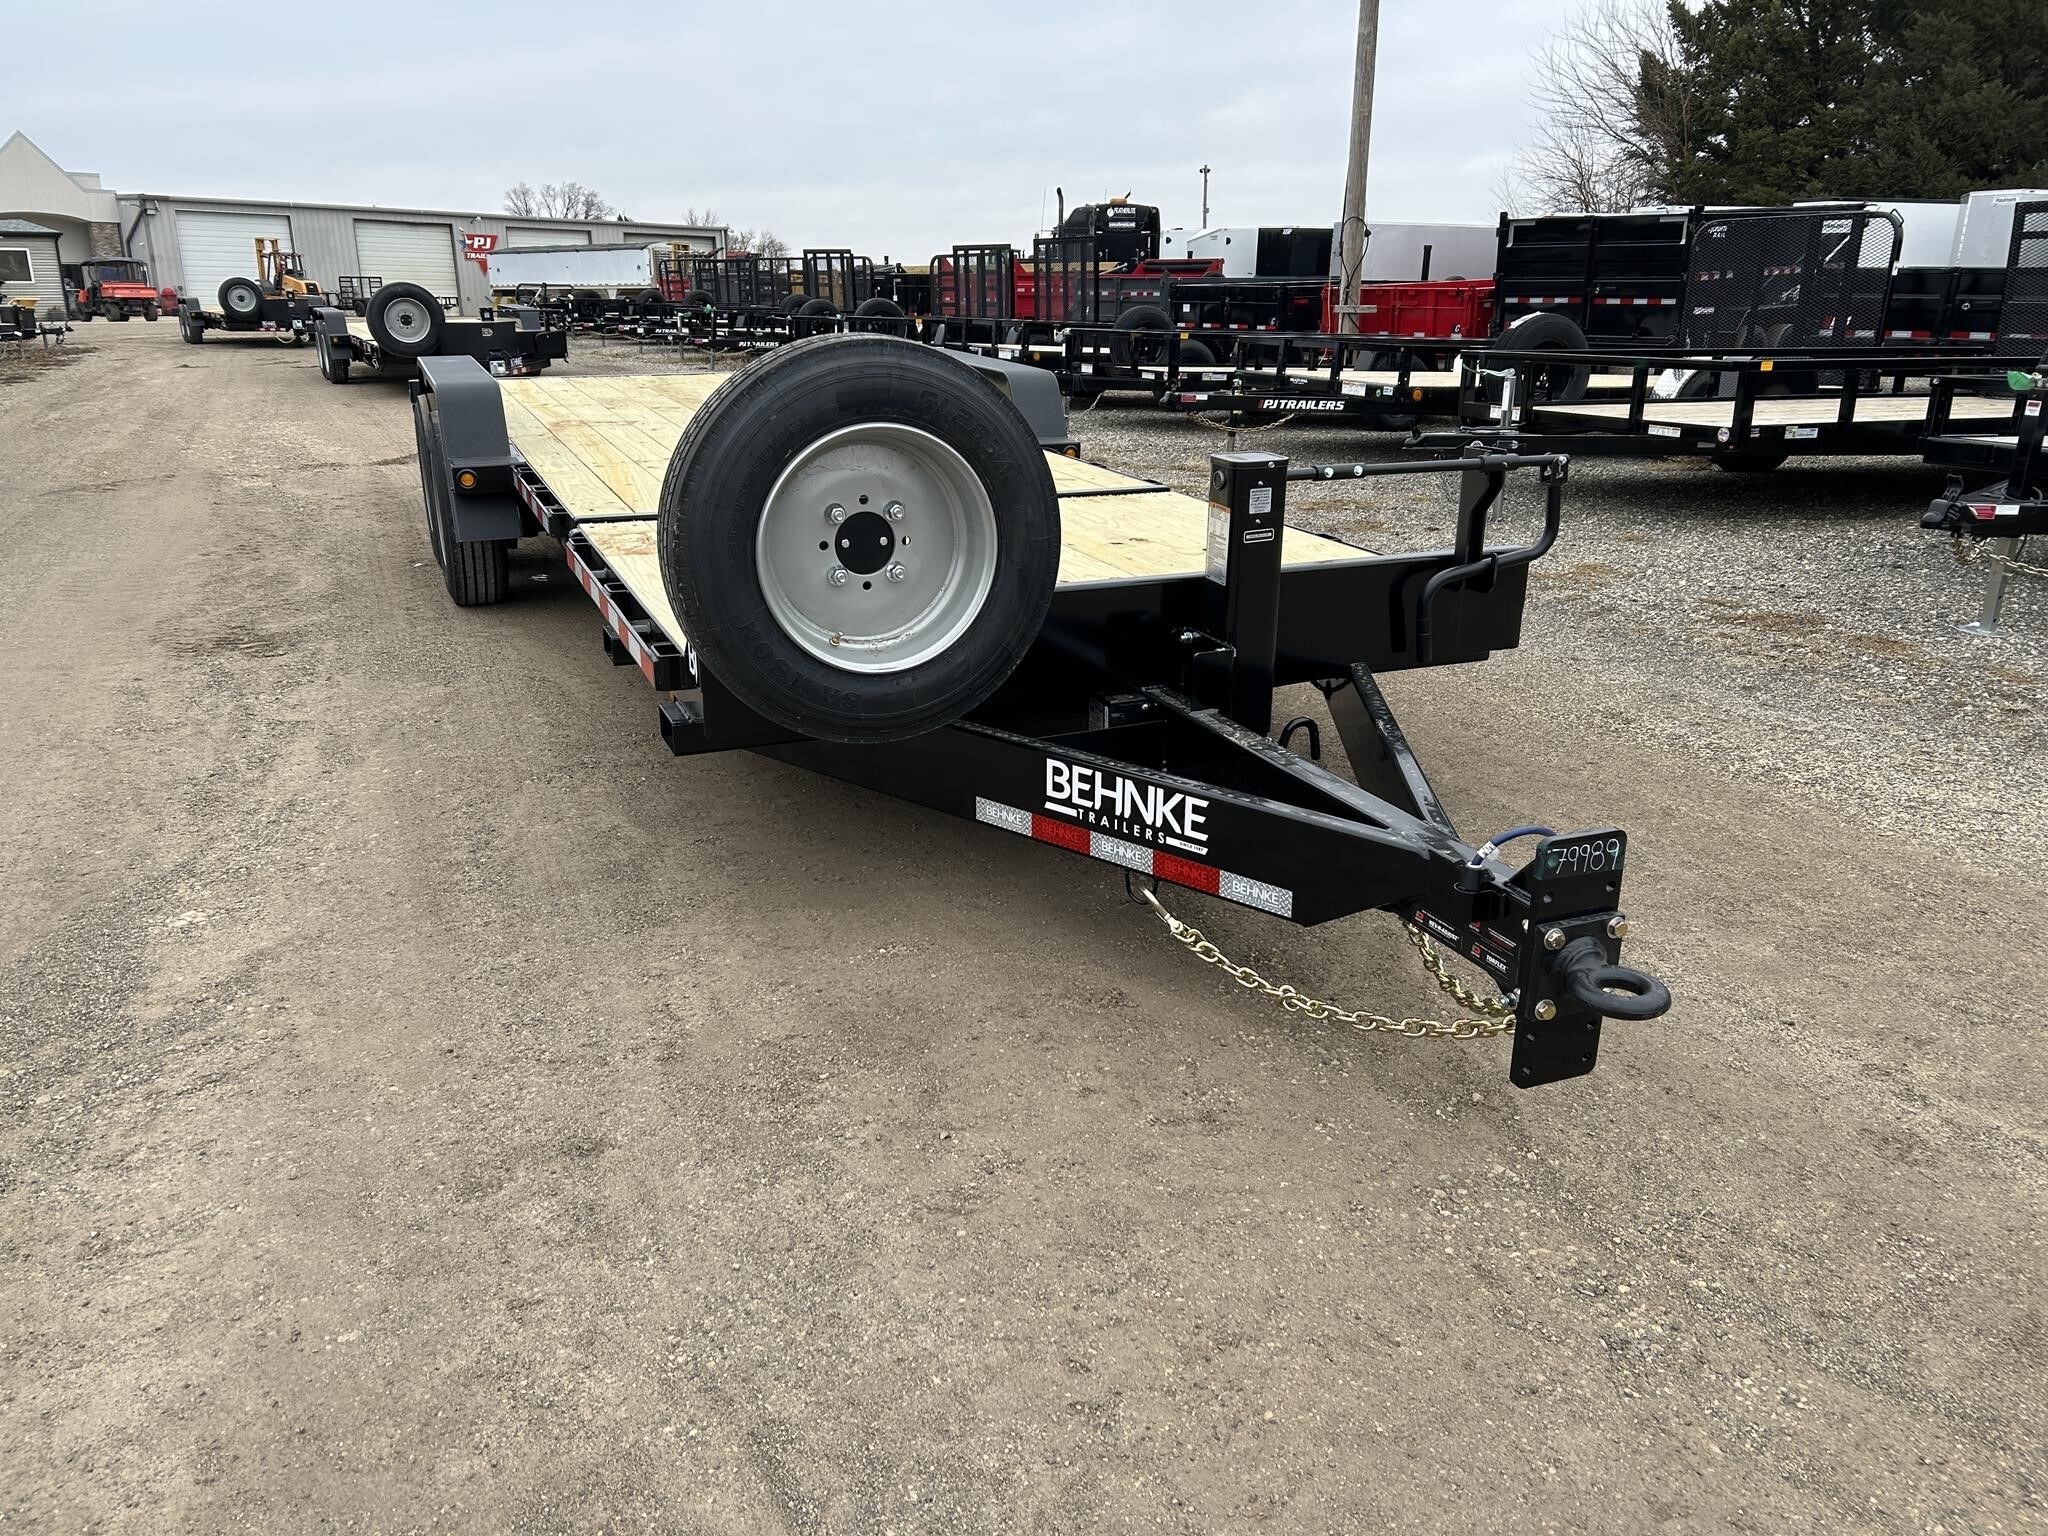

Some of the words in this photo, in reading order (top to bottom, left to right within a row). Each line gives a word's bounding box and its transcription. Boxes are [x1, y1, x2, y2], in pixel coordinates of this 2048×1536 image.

[473, 236, 492, 249] PJ
[1263, 399, 1279, 409] PJ
[1279, 399, 1346, 411] TRAILERS
[1046, 758, 1210, 841] BEHNKE
[986, 805, 1022, 825] BEHNKE
[1077, 808, 1165, 844] TRAILERS
[1042, 823, 1081, 842] BEHNKE
[1101, 841, 1142, 863] BEHNKE
[1552, 838, 1620, 874] 79989
[1164, 860, 1208, 882] BEHNKE
[1232, 880, 1279, 905] BEHNKE
